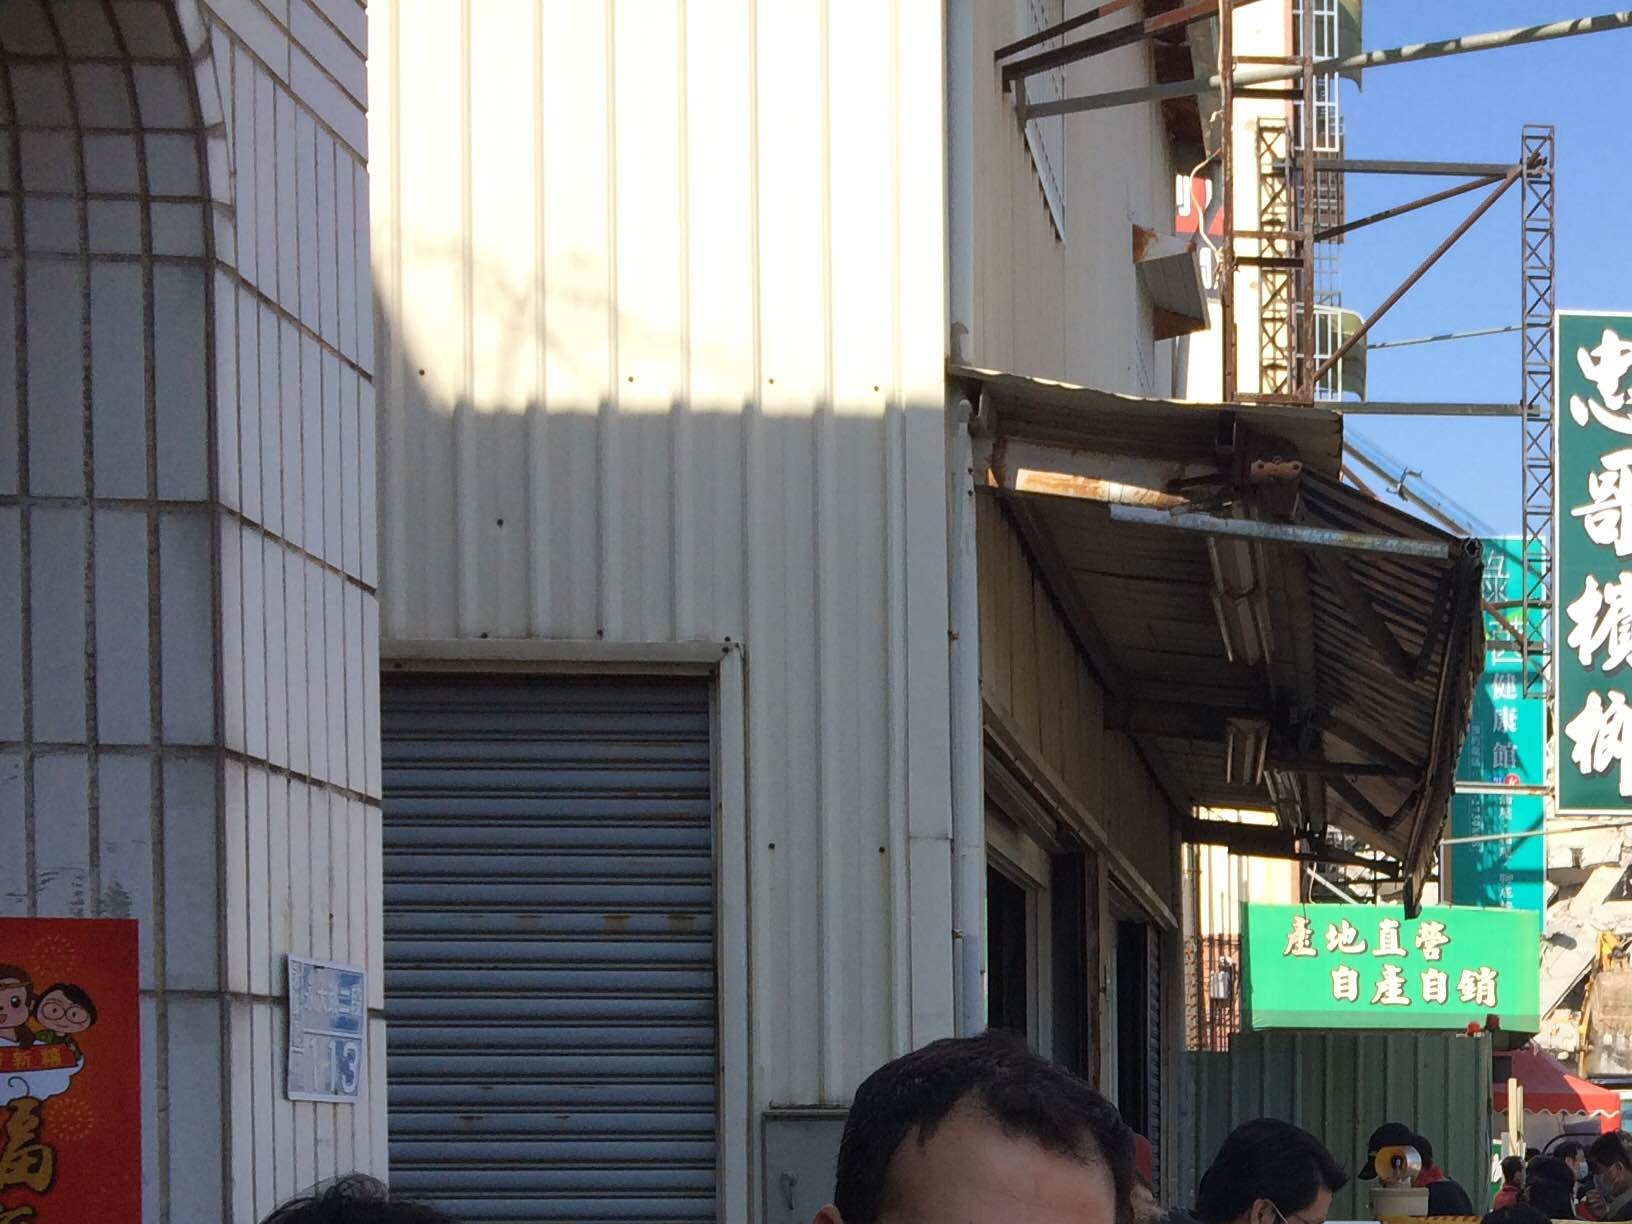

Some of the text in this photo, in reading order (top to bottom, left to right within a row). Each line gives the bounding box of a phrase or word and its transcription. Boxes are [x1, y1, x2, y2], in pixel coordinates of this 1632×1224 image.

[1283, 917, 1451, 958] 產地直營
[1330, 963, 1499, 1008] 自產自銷
[311, 1037, 360, 1094] 113
